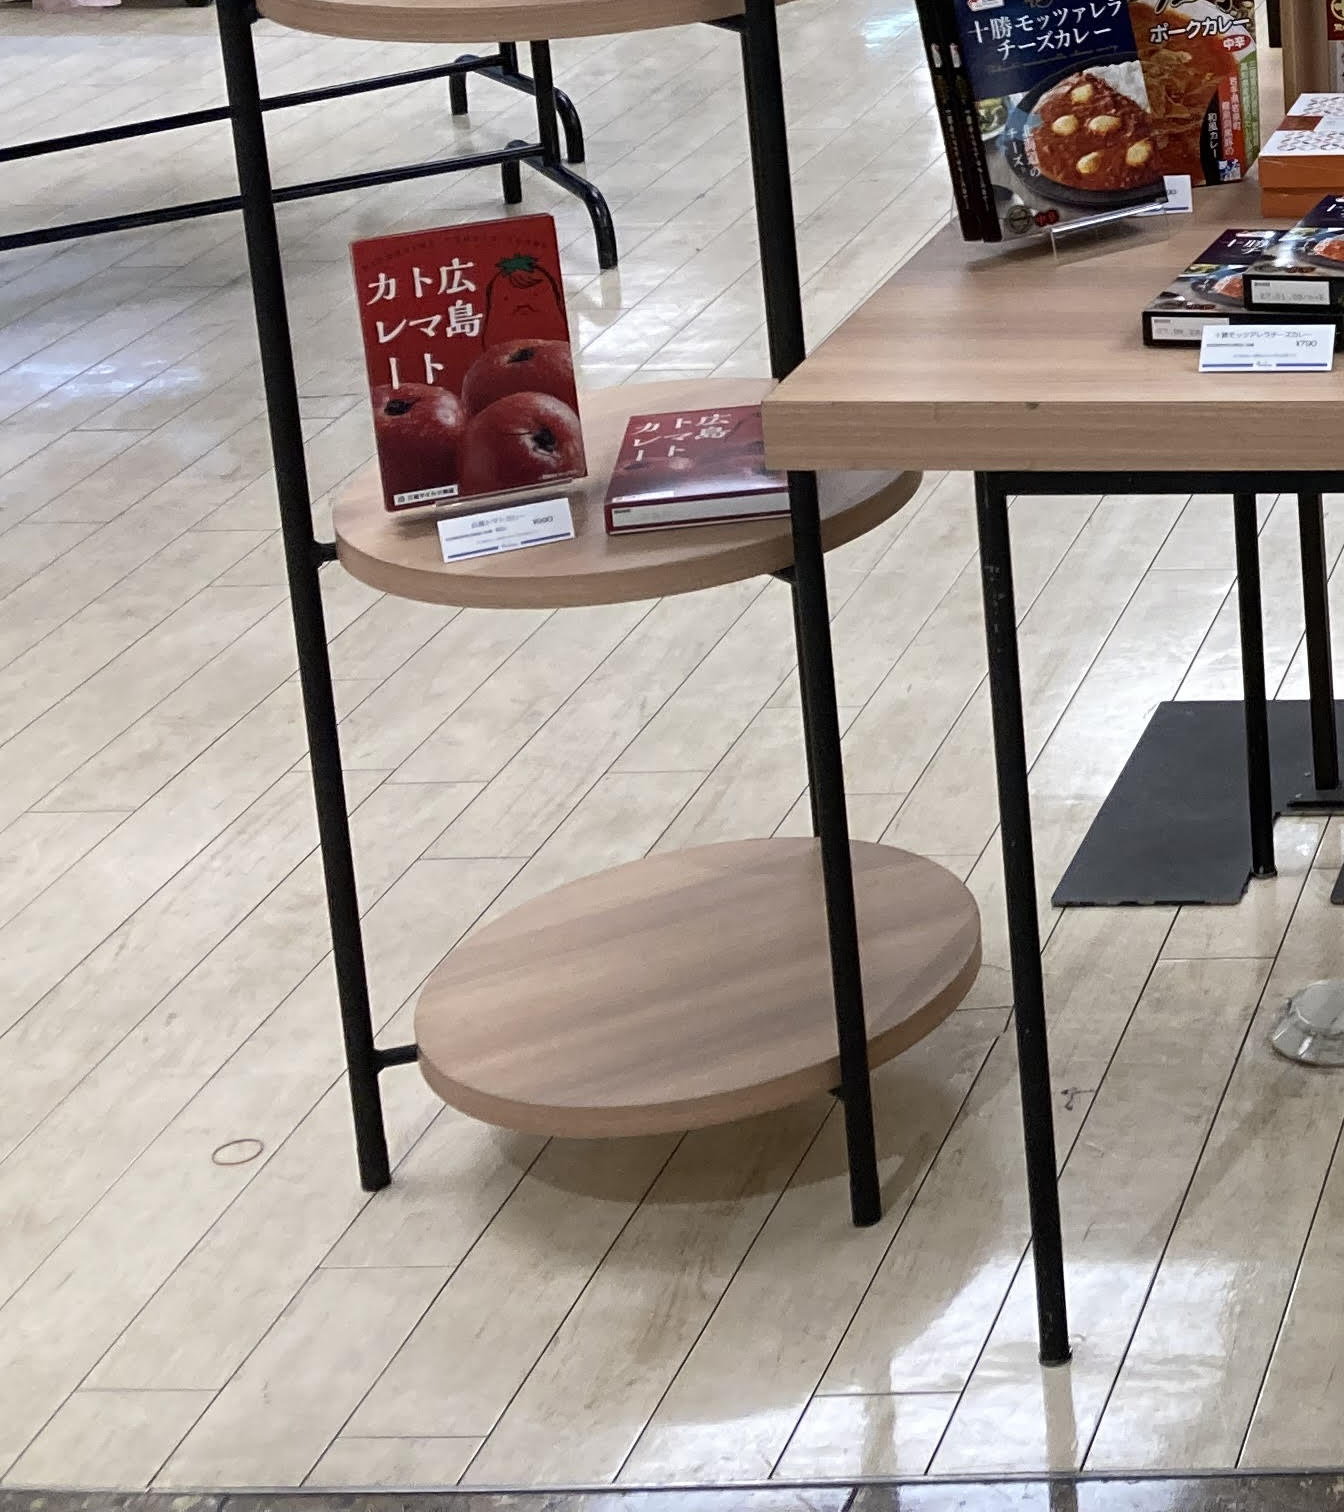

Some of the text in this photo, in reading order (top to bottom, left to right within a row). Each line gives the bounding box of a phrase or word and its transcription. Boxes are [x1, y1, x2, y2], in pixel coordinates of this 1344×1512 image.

[997, 25, 1112, 61] チーズカレー
[1150, 17, 1251, 44] ポークカレー
[408, 266, 445, 385] トマト
[437, 257, 484, 340] 広島
[366, 272, 409, 390] カレー
[694, 413, 732, 440] 広島
